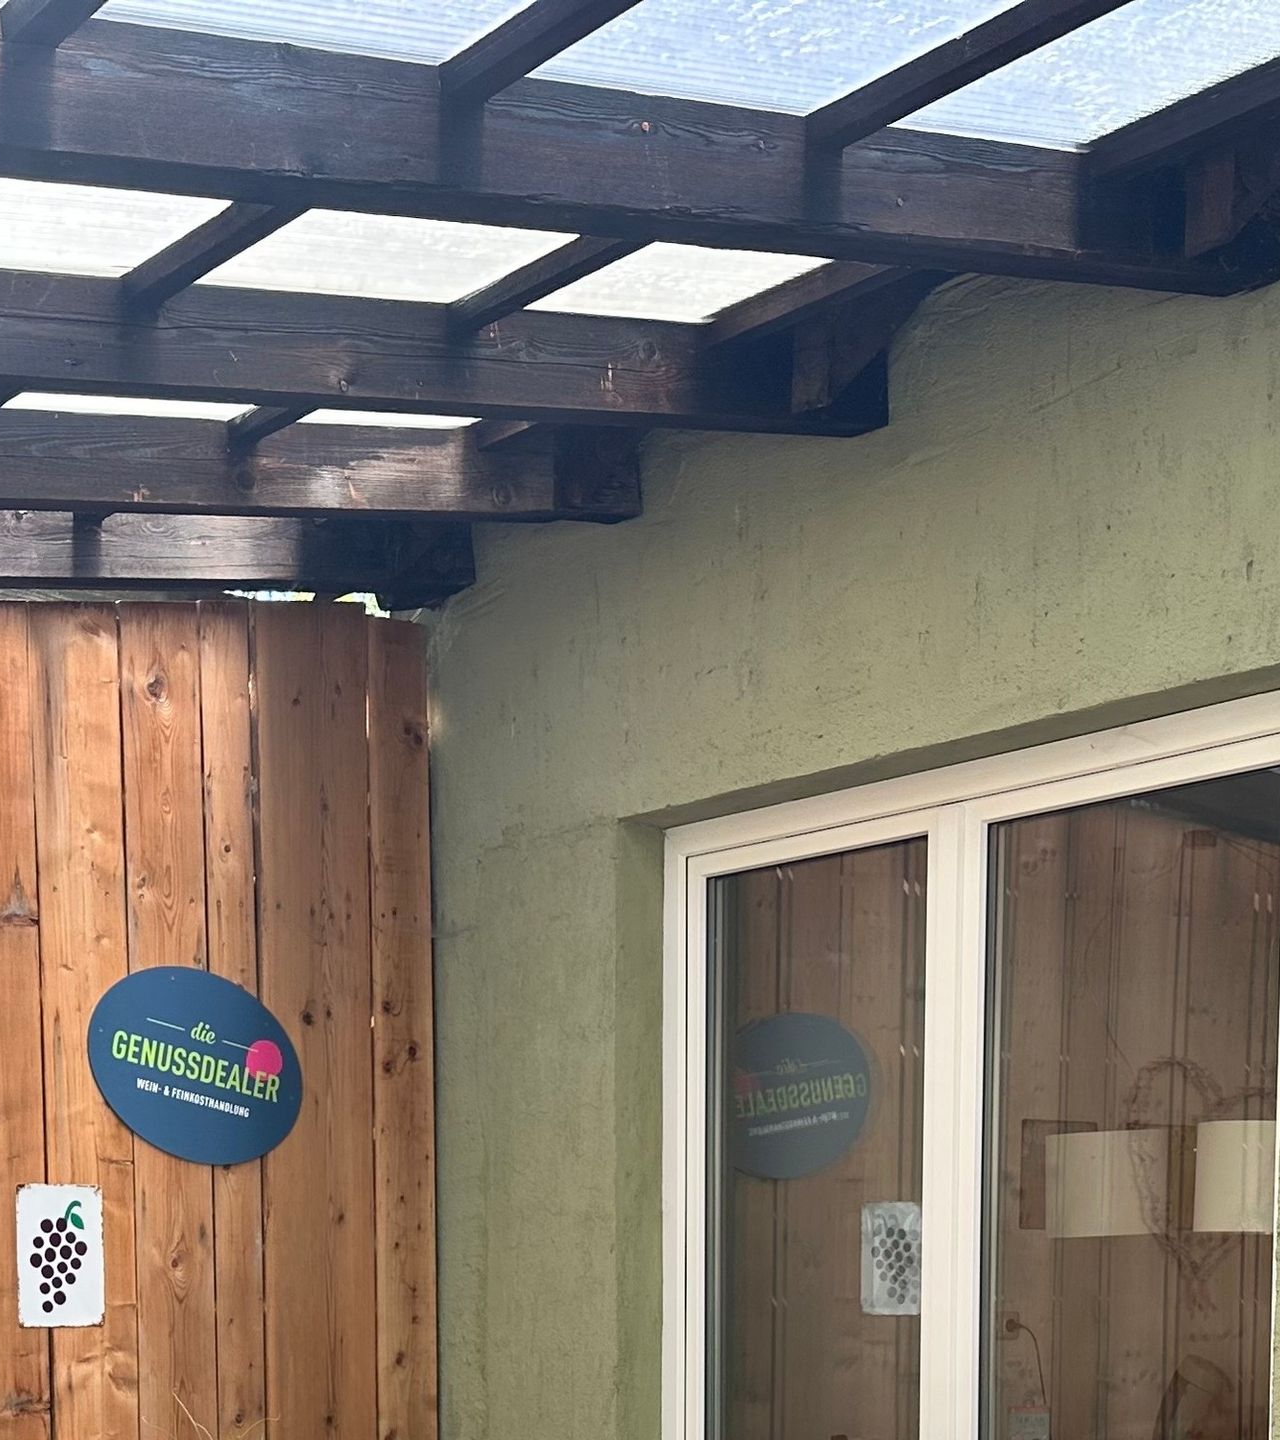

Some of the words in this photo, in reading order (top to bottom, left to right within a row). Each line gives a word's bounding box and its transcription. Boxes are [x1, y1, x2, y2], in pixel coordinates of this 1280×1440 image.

[190, 1021, 216, 1045] die
[111, 1029, 281, 1103] GENUSSDEALER
[136, 1077, 163, 1094] WEIN-
[163, 1086, 170, 1097] &
[171, 1087, 251, 1118] FEINKOSTHANDLUNG
